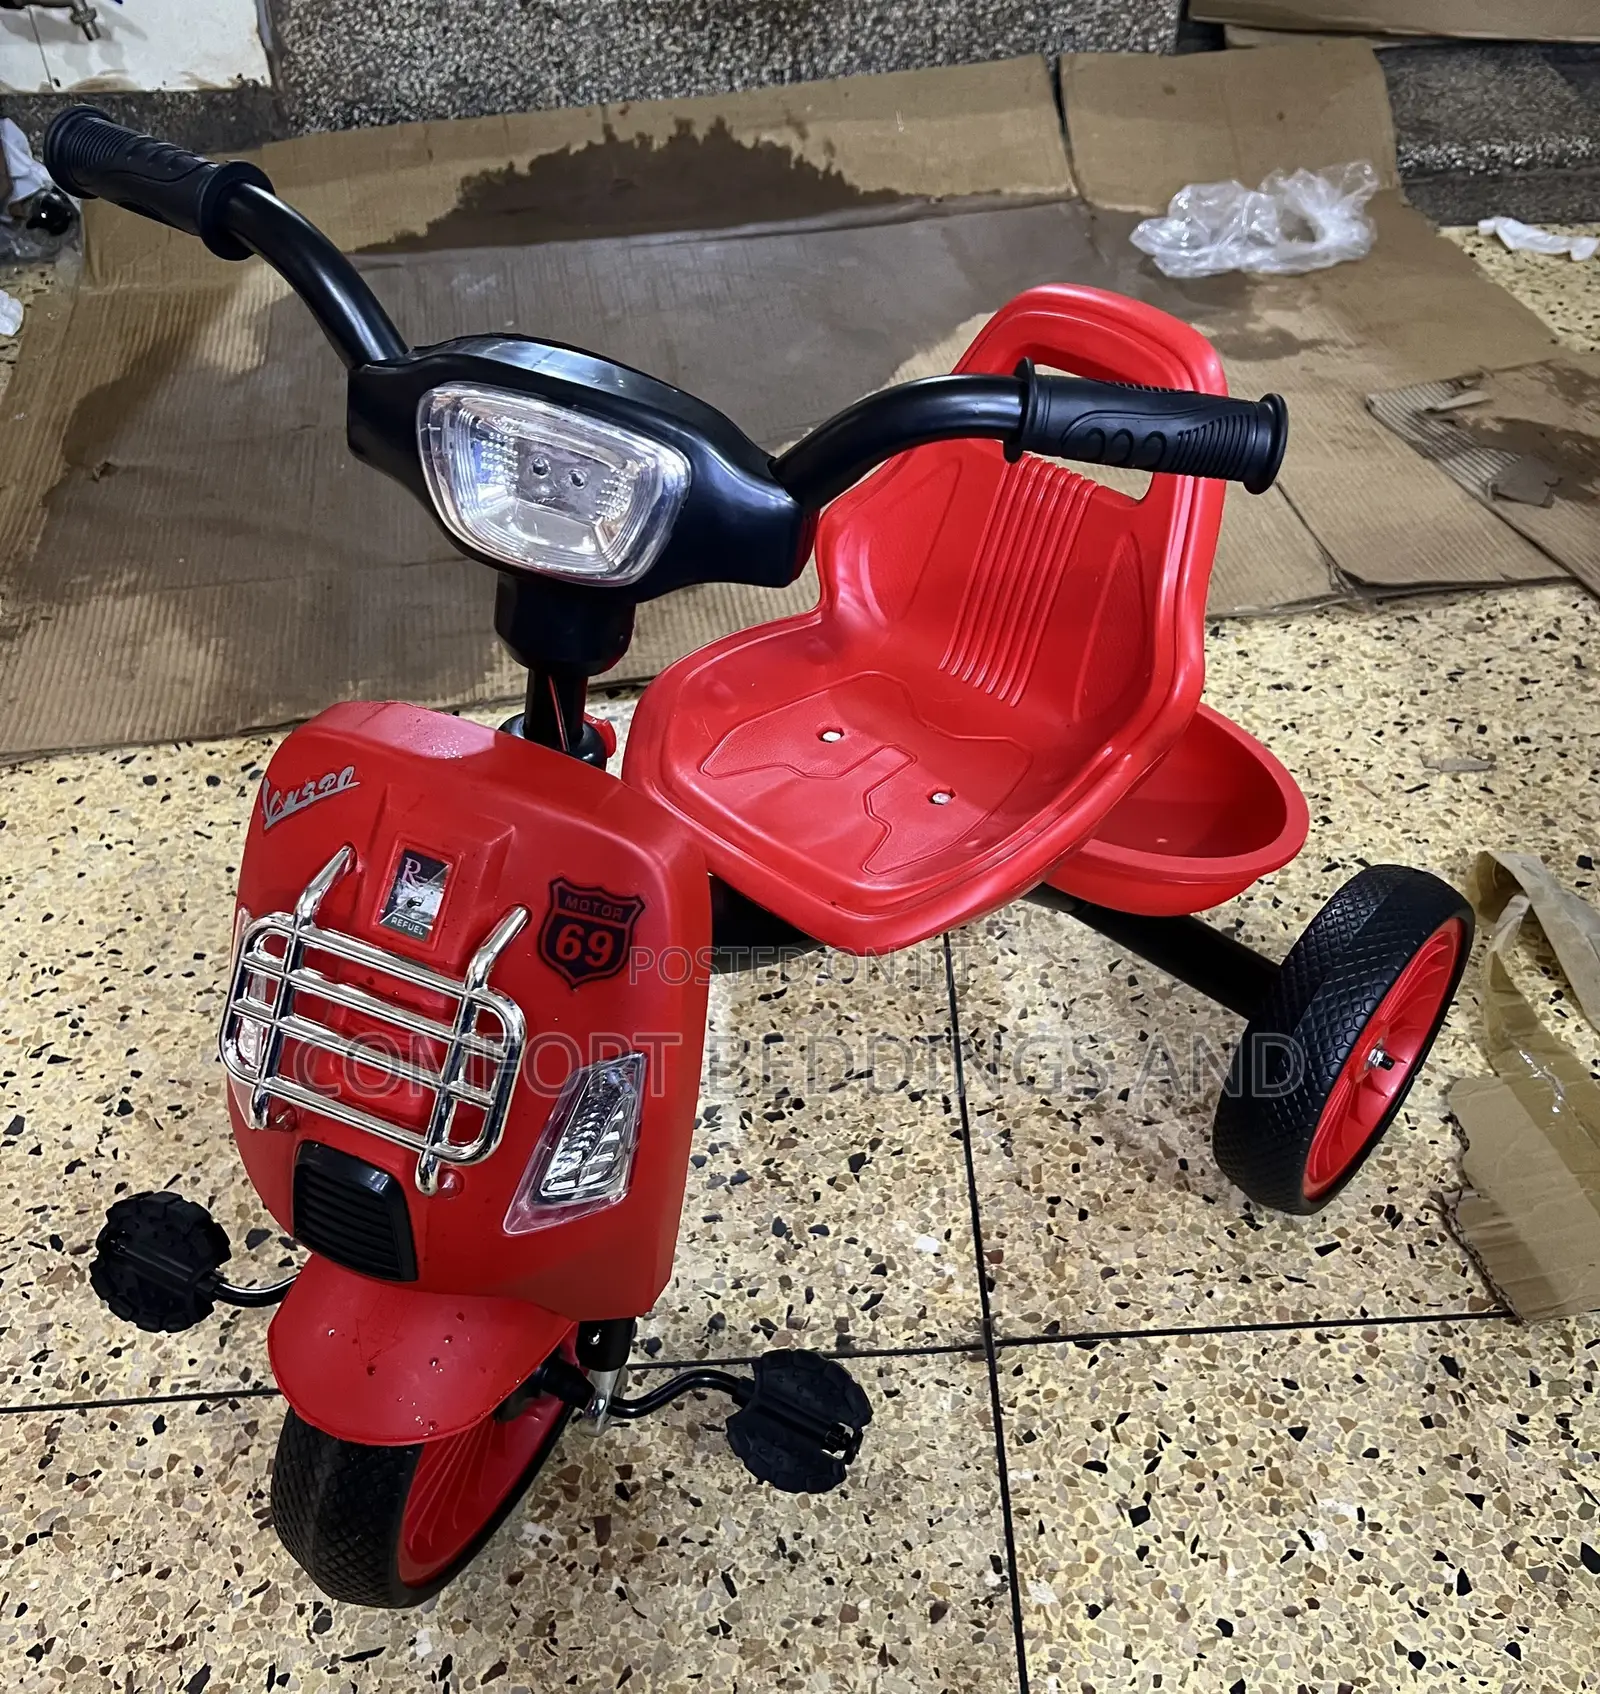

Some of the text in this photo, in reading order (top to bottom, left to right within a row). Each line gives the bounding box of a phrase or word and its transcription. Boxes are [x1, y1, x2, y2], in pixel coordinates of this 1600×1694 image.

[565, 896, 623, 919] MOTOR
[391, 916, 424, 935] REFUEL
[555, 924, 613, 968] 69
